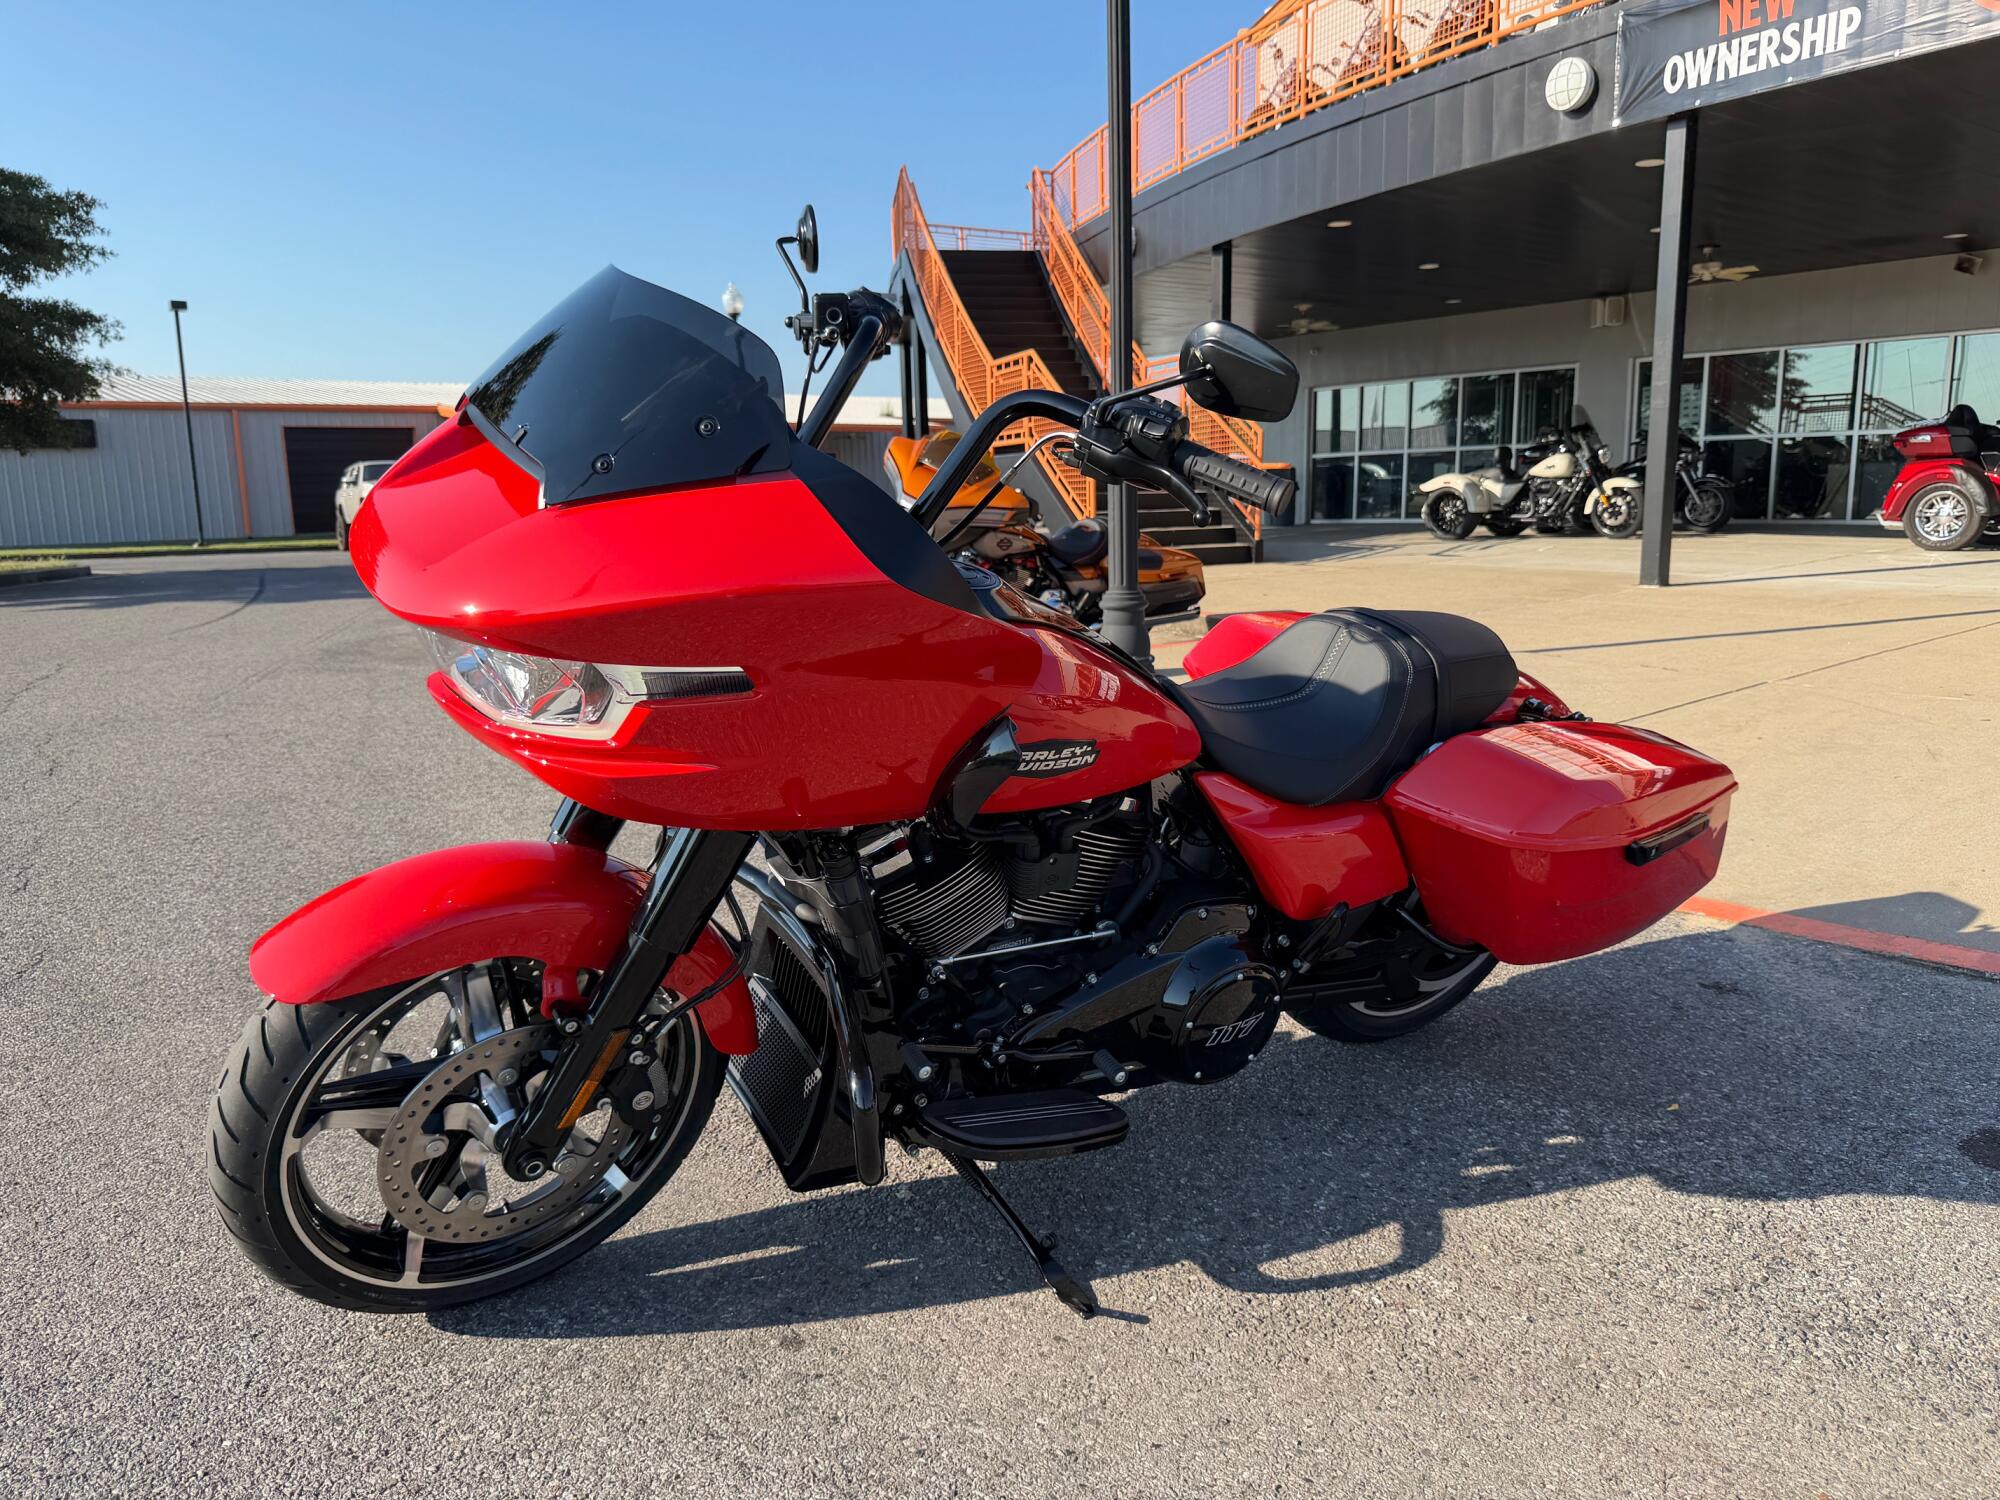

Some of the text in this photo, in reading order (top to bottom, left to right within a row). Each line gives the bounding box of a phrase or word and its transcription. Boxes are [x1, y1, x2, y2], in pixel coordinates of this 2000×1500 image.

[1719, 0, 1795, 36] NEW
[1663, 6, 1862, 94] OWNERSHIP
[1017, 753, 1097, 771] VIDSON
[1021, 745, 1092, 761] ARLEY-
[1205, 1011, 1265, 1047] 117
